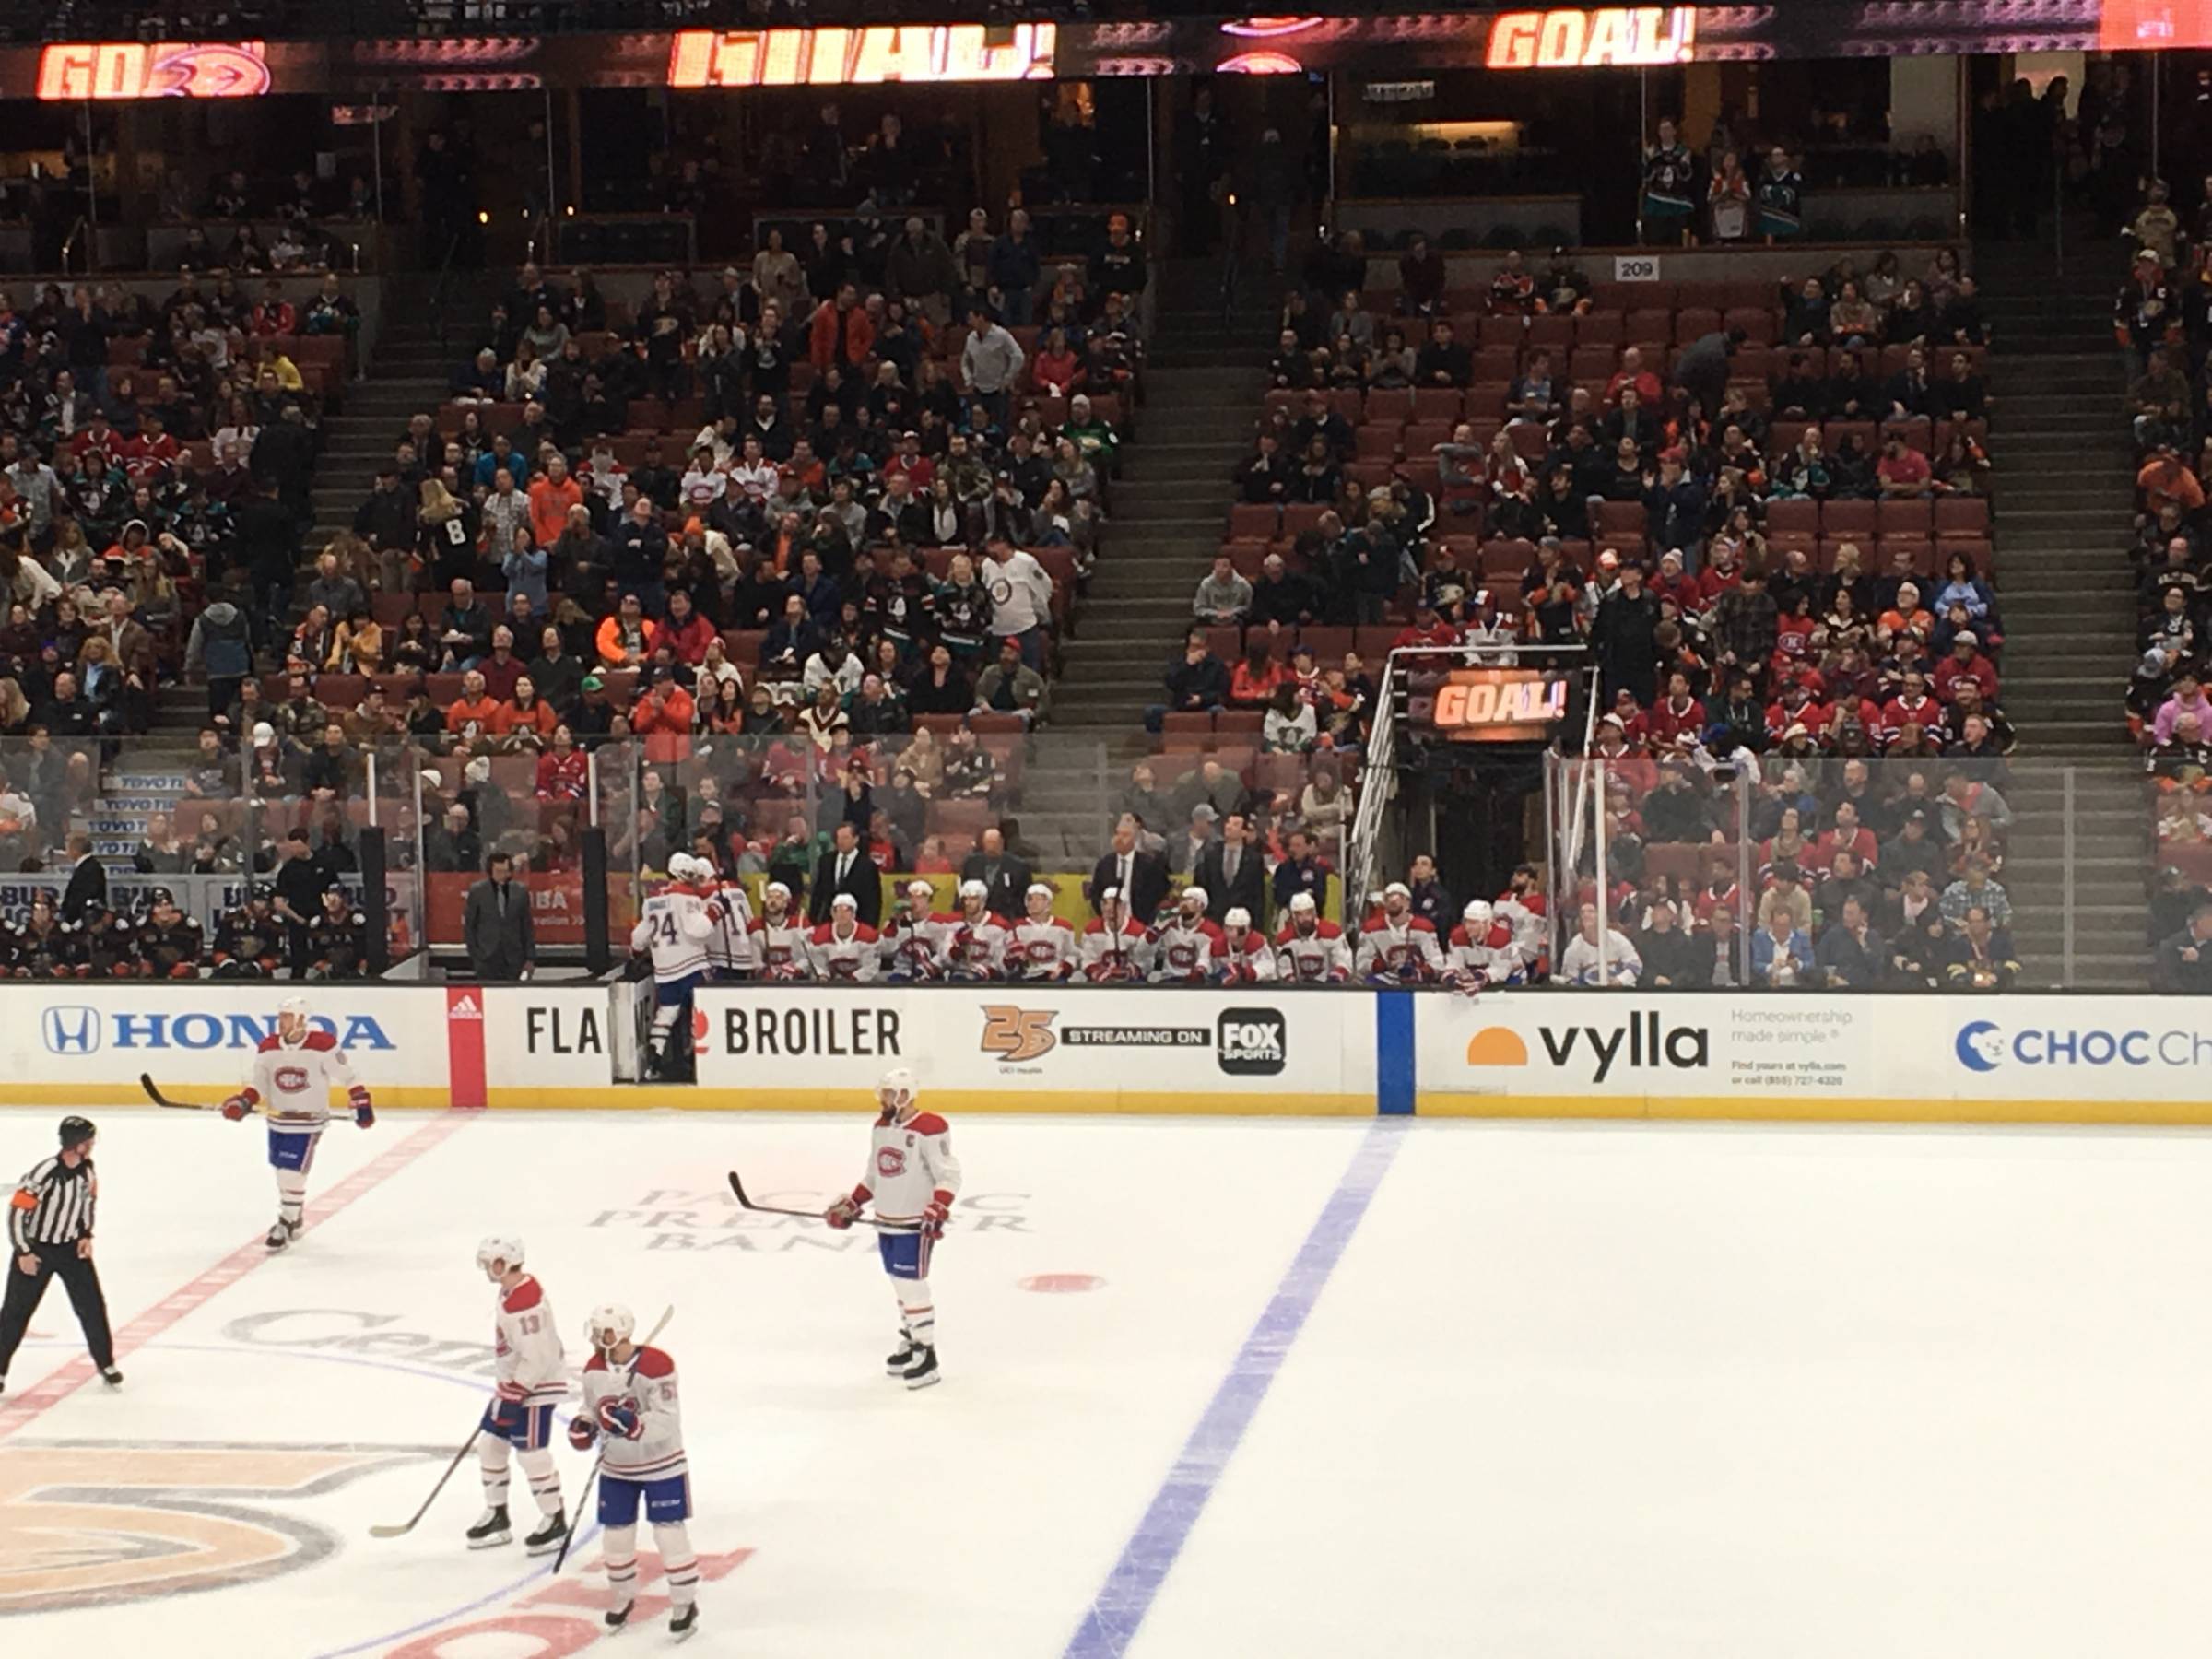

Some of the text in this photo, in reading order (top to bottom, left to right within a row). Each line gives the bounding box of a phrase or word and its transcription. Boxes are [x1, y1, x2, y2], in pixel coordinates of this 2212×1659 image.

[1486, 6, 1696, 68] GOAL!
[1621, 261, 1653, 276] 209
[1434, 680, 1567, 726] GOAL!
[649, 912, 679, 949] 24
[527, 1007, 901, 1055] FLA BROILER
[1731, 1009, 1853, 1025] Homeownership
[1068, 1029, 1202, 1043] STREAMING ON
[1223, 1023, 1280, 1048] FOX
[1537, 1010, 1710, 1084] vylla
[1731, 1029, 1827, 1044] made simple
[2013, 1030, 2151, 1065] CHOC
[1224, 1049, 1282, 1061] SPORTS
